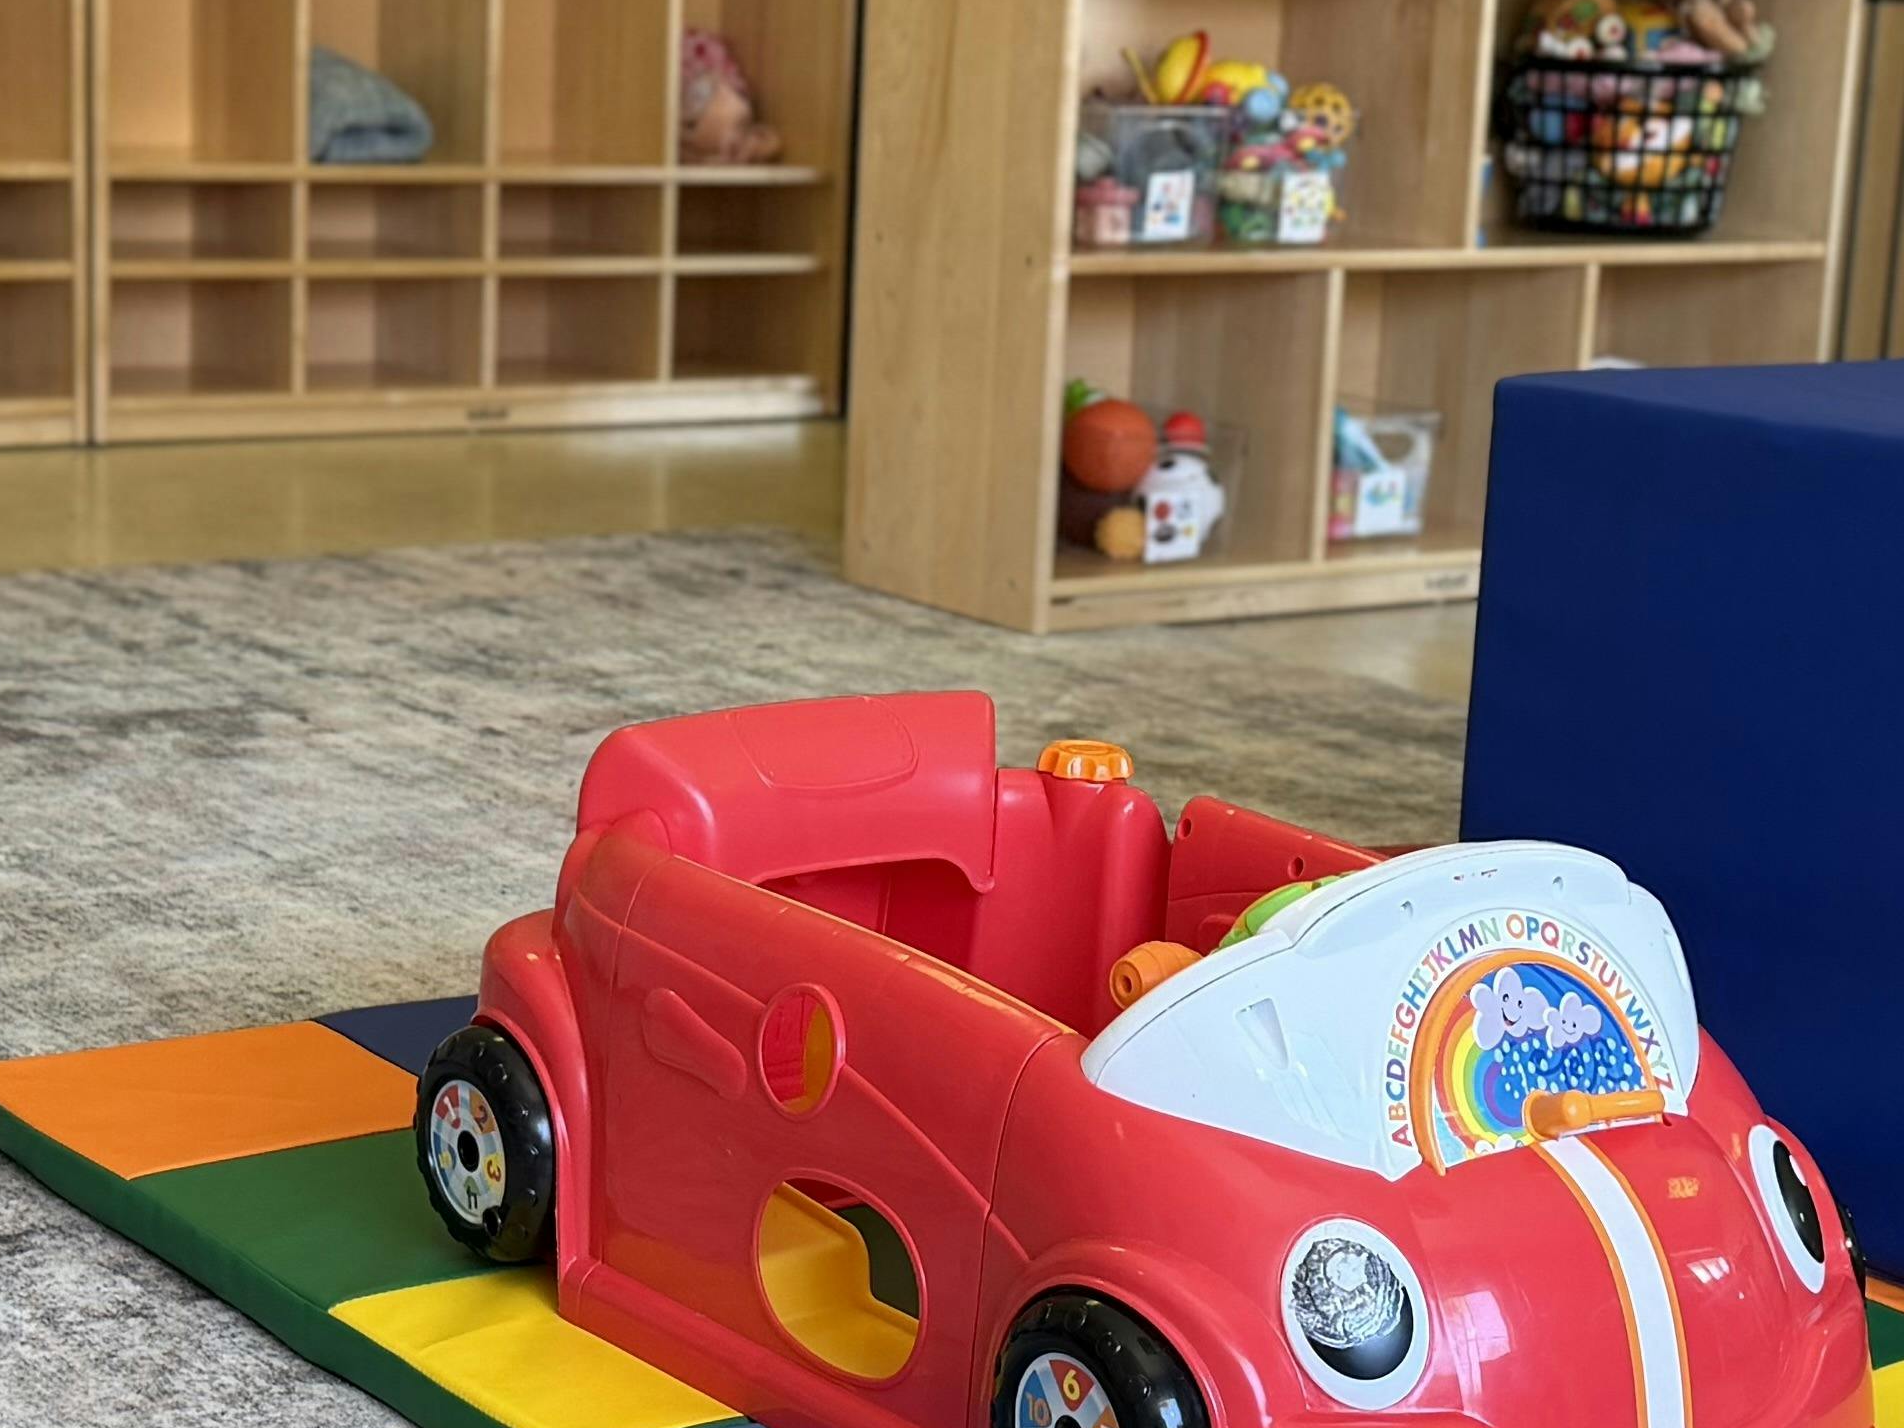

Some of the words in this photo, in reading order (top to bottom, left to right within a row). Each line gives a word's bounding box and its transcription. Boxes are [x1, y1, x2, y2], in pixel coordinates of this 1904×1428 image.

[487, 1159, 501, 1183] 3
[1063, 1369, 1080, 1401] 6
[1026, 1392, 1052, 1427] 10
